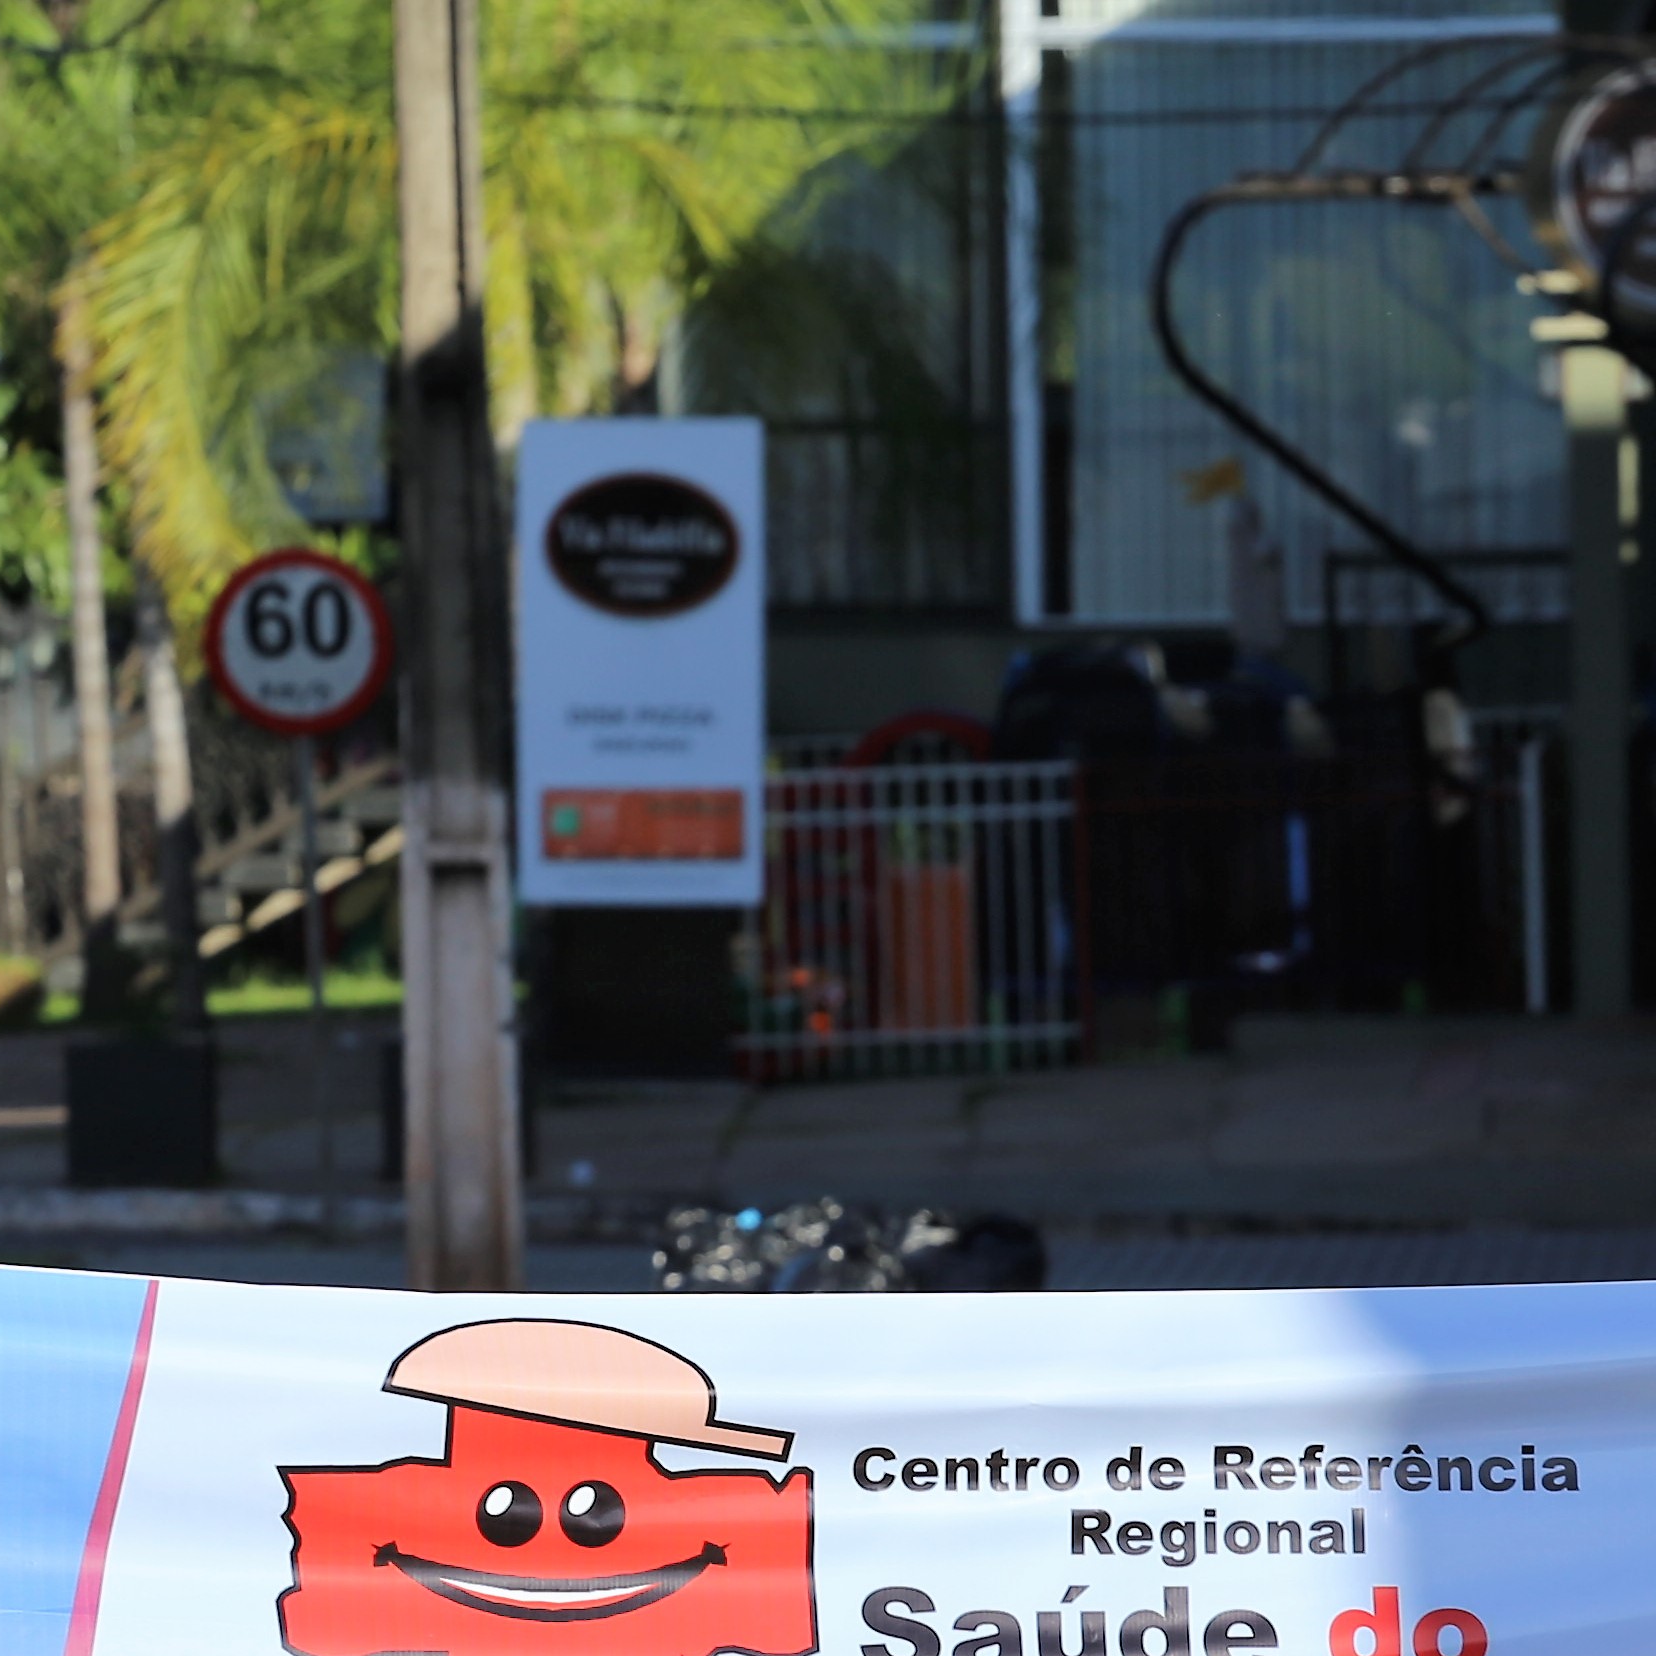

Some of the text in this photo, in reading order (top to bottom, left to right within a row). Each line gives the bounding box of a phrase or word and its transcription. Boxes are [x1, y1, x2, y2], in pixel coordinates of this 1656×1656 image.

[245, 581, 350, 659] 60
[852, 1443, 1581, 1494] Centro de Referência
[1070, 1507, 1367, 1567] Regional
